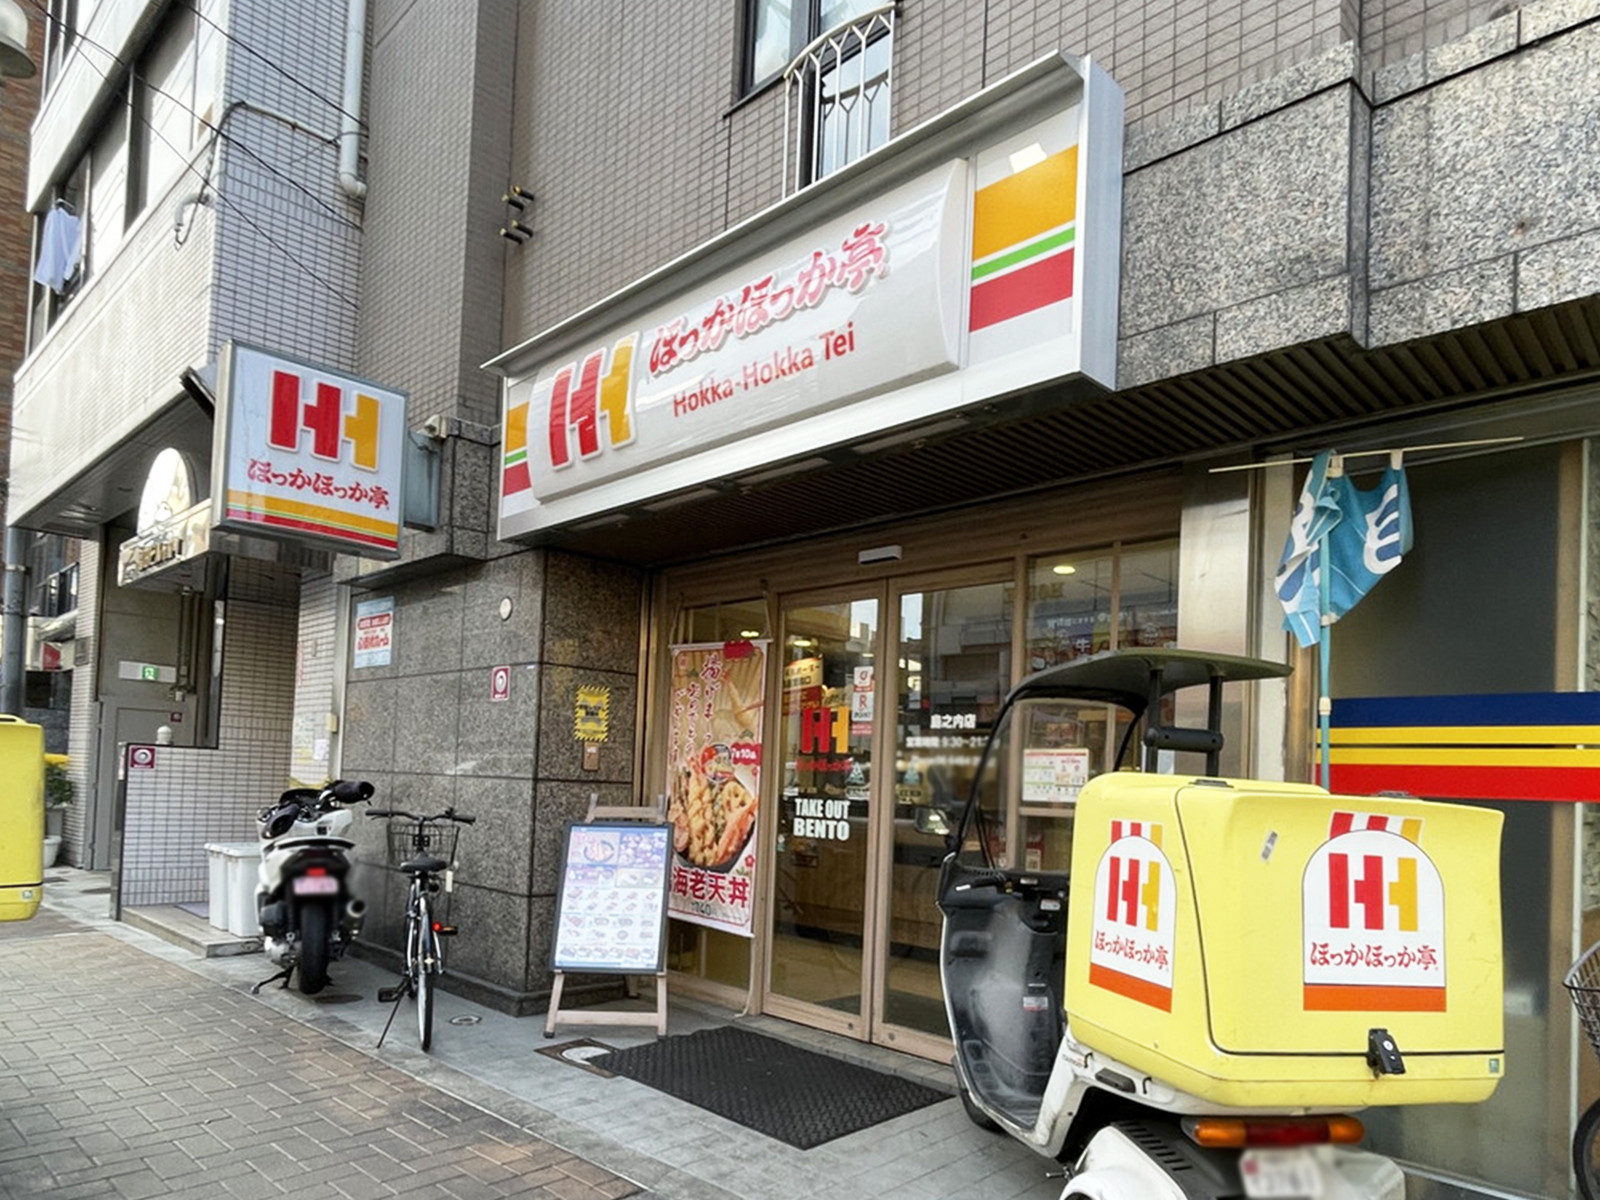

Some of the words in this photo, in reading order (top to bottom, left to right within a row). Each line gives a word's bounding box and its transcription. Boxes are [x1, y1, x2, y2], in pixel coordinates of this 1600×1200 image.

[649, 222, 888, 375] ほっかほっか亭
[673, 345, 815, 418] Hokka-Hokka
[821, 321, 855, 362] Tei
[248, 457, 390, 511] ほっかほっか亭
[793, 817, 850, 841] BENTO
[794, 798, 824, 819] TAKE
[825, 799, 850, 820] OUT
[673, 866, 749, 908] 海老天丼
[1095, 931, 1168, 973] ほっかほっか亭
[1310, 942, 1438, 970] ほっかほっか亭
